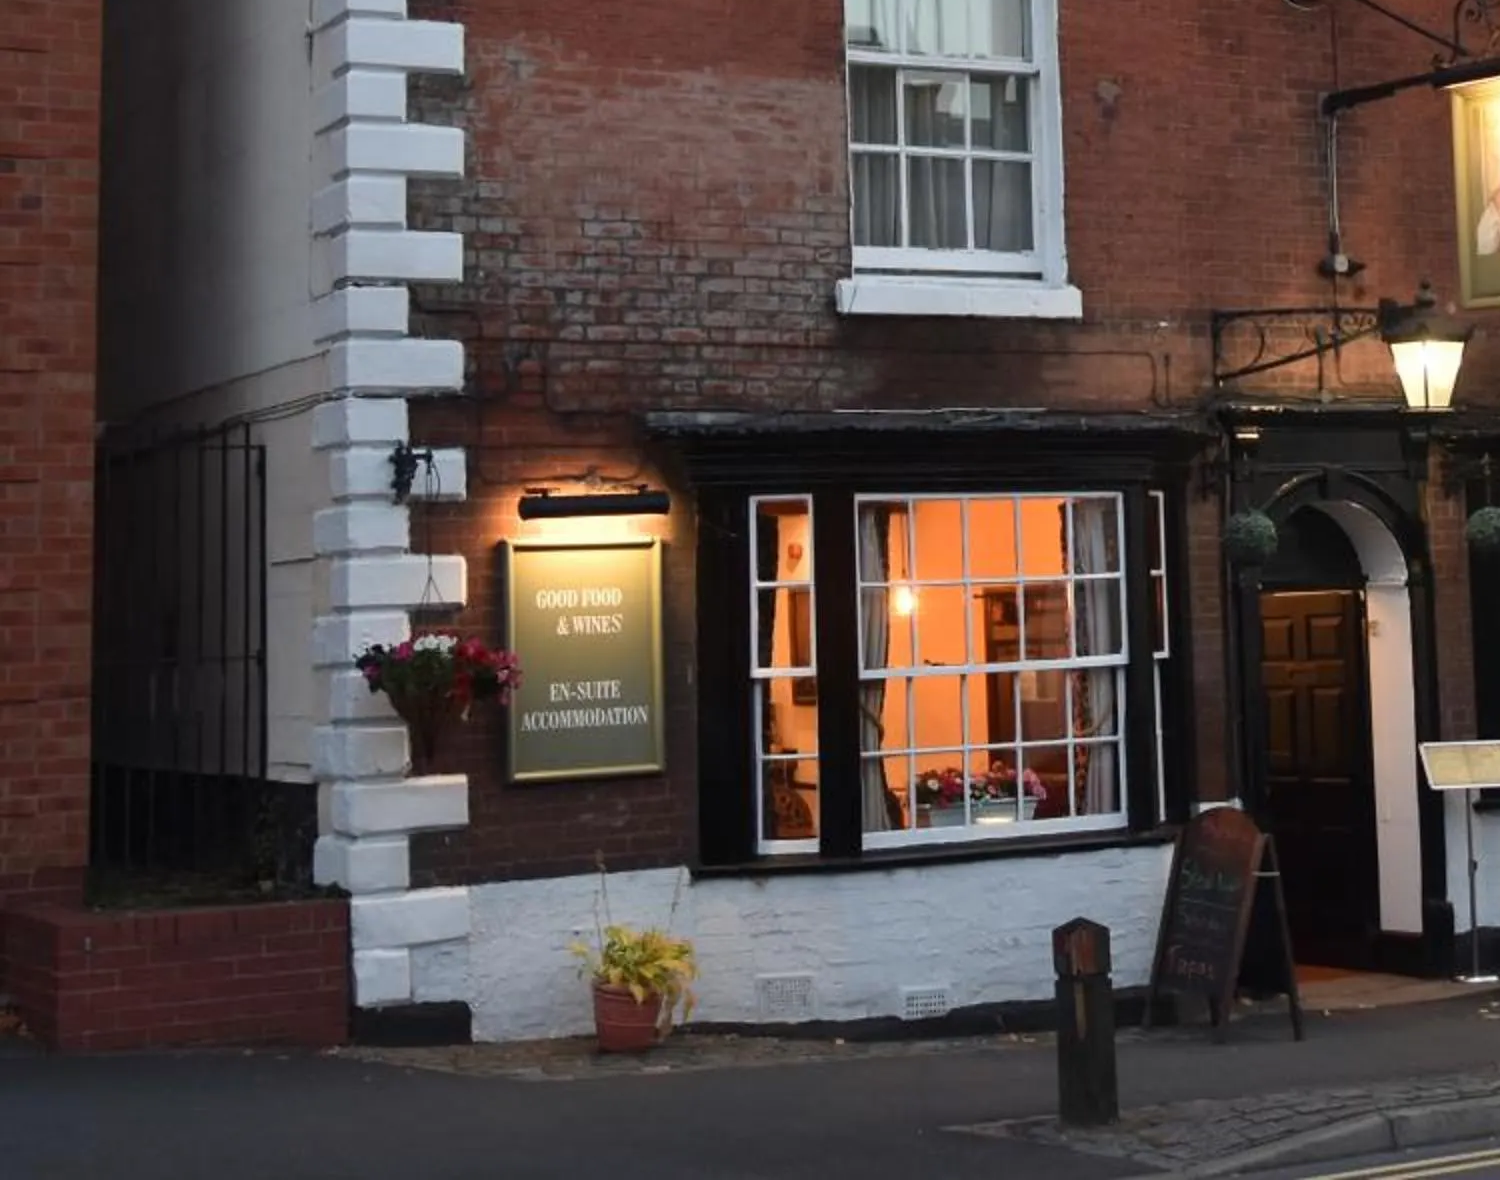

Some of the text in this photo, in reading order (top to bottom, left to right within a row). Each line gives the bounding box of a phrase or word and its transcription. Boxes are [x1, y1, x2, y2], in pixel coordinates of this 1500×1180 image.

[536, 587, 623, 609] GOOD FOOD
[556, 613, 624, 635] & WINES
[550, 679, 621, 702] EN-SUITE
[520, 704, 648, 731] ACCOMMODATION
